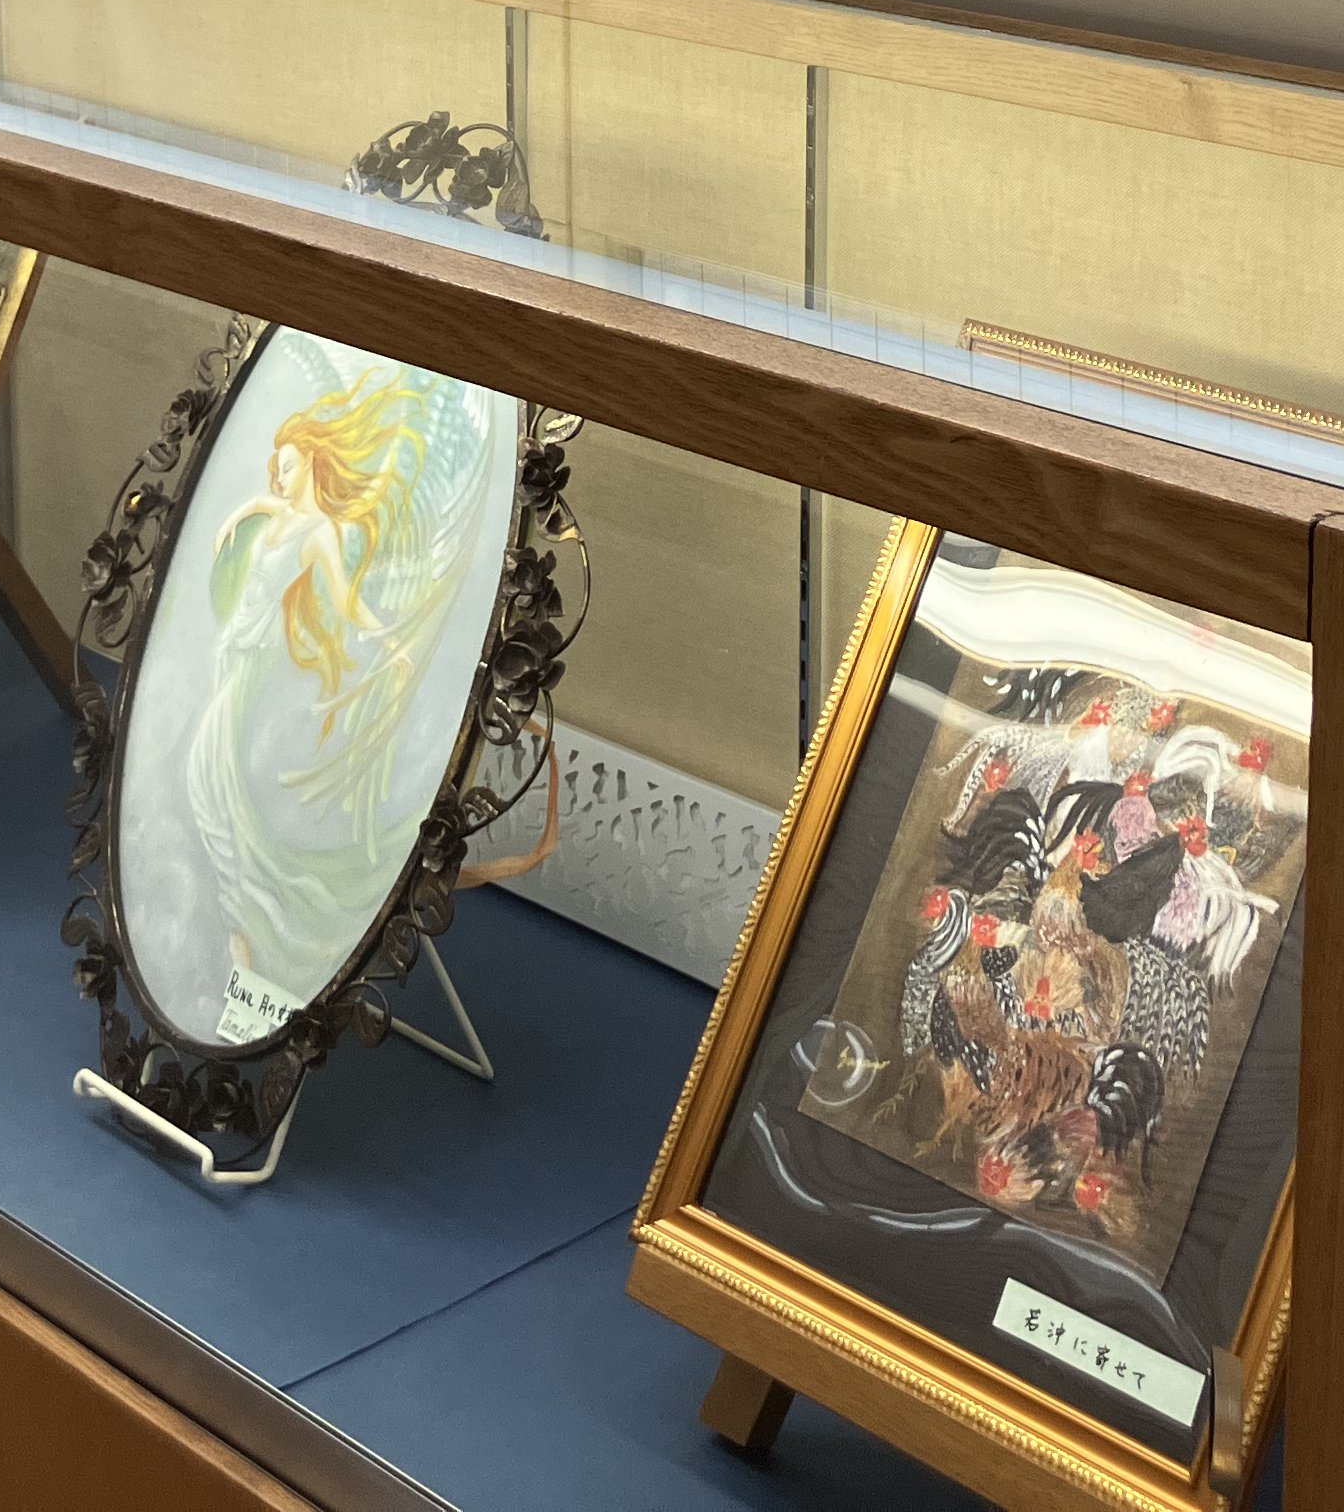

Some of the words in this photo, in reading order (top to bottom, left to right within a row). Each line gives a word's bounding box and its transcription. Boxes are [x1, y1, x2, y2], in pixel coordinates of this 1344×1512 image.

[1023, 1308, 1147, 1390] 若冲に寄せて
